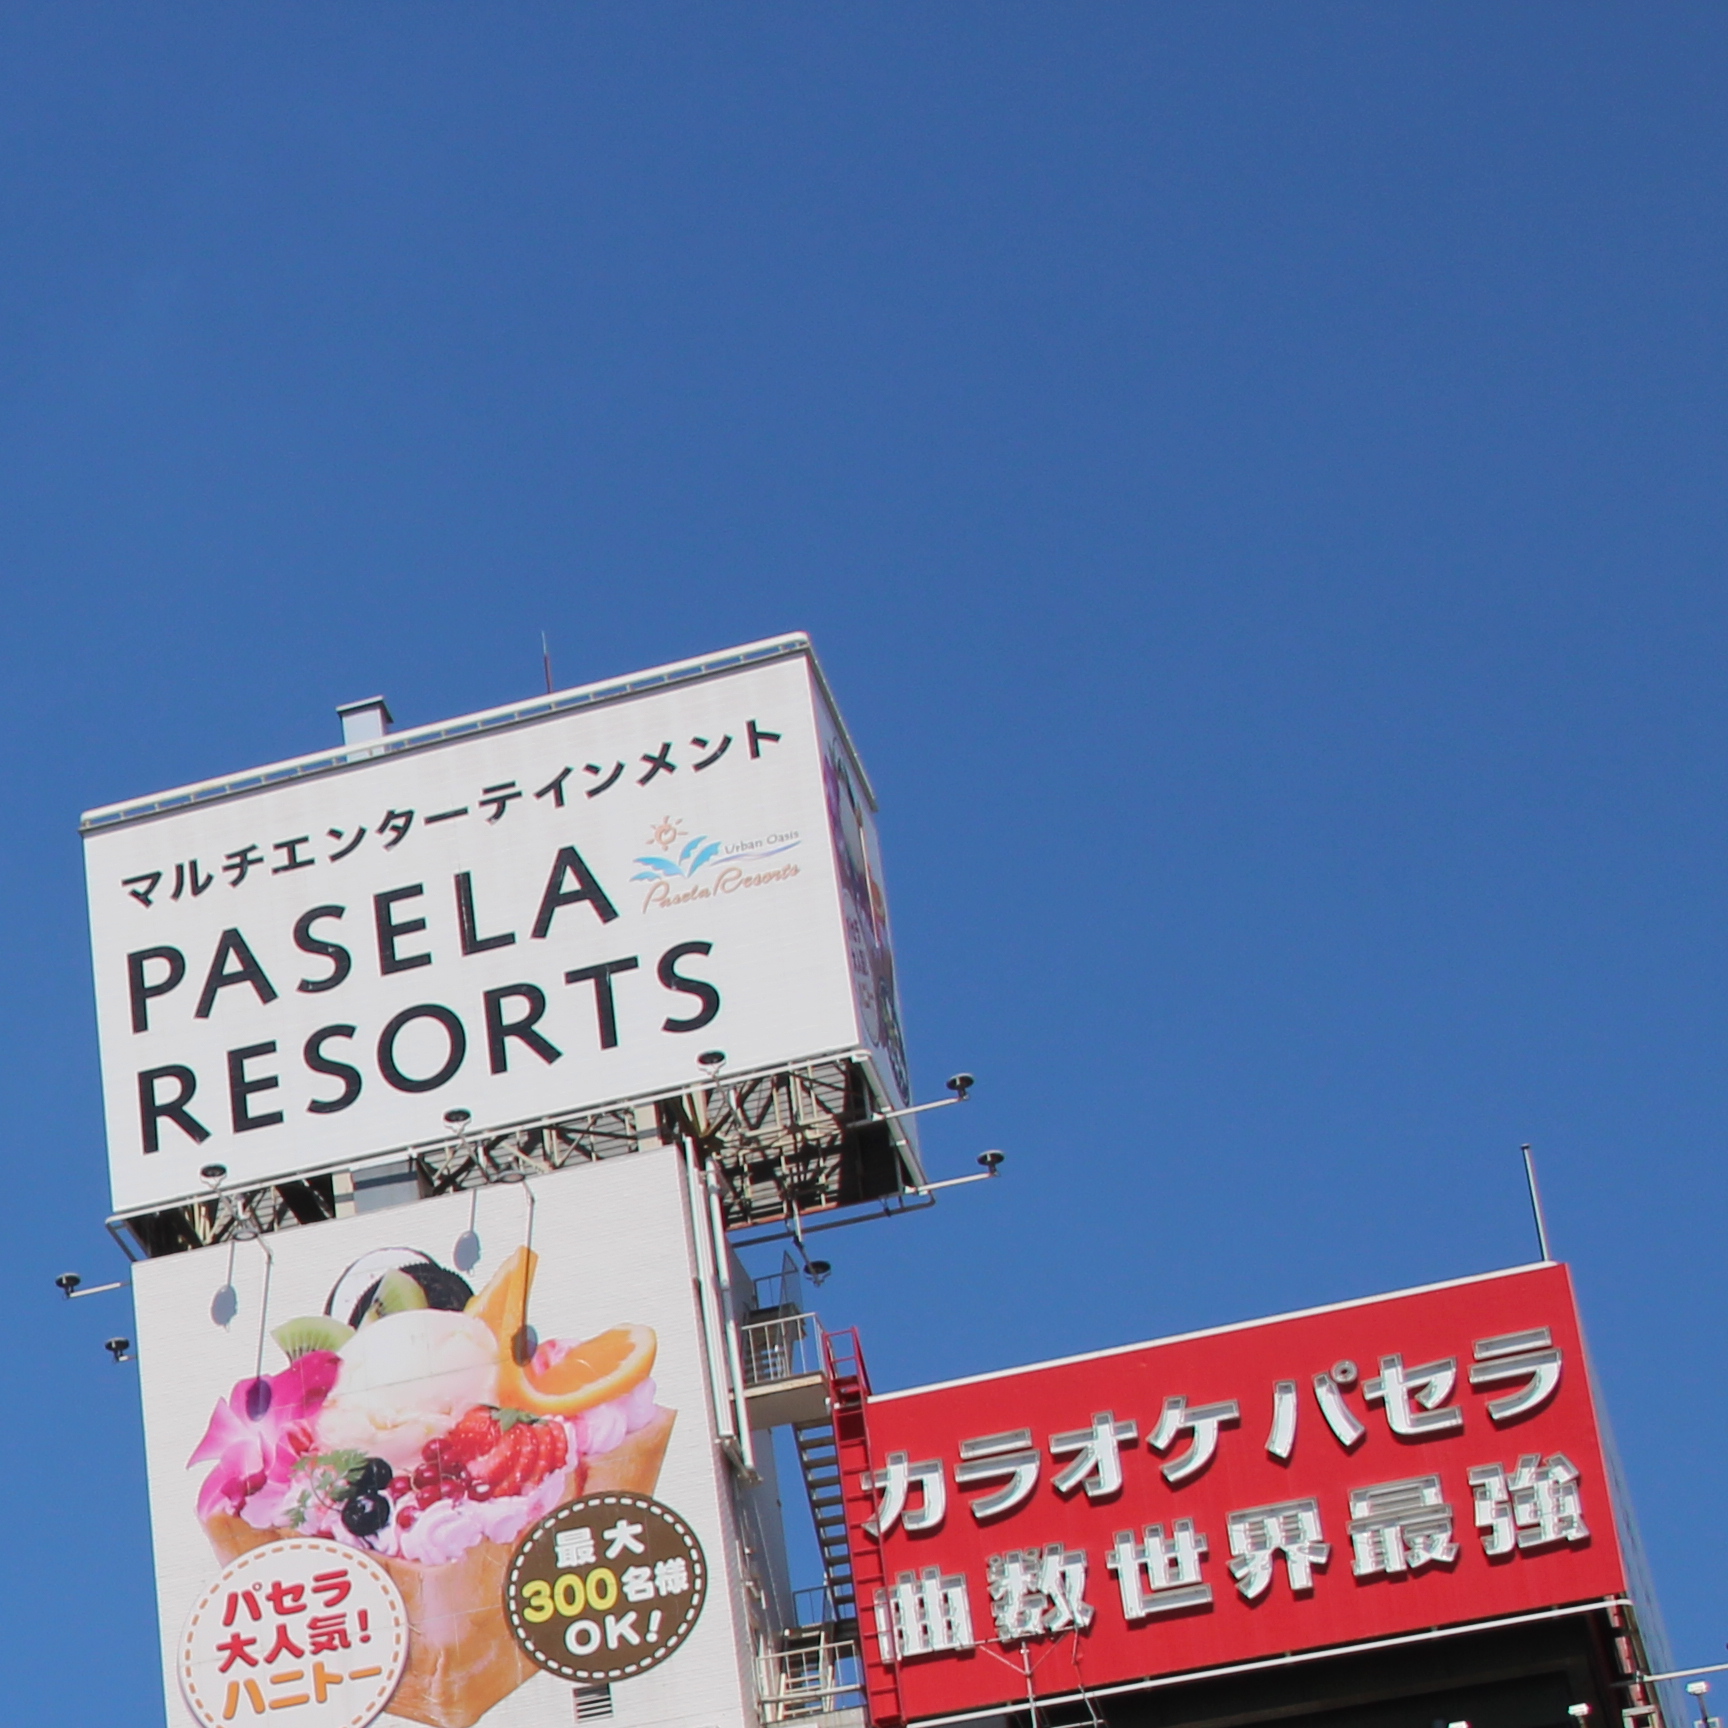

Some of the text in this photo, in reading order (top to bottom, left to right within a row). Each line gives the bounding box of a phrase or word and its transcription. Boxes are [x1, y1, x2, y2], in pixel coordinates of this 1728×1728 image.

[122, 719, 783, 908] マルチエンターテインメント
[725, 831, 799, 854] Urban Oasis
[643, 864, 800, 914] Pasela Resorts
[126, 845, 619, 1034] PASELA
[137, 941, 721, 1155] RESORTS
[553, 1519, 645, 1568] 最大
[875, 1452, 1590, 1663] 曲数世界最強
[222, 1569, 353, 1628] パセラ
[564, 1609, 663, 1657] OK!
[223, 1659, 383, 1721] ハニトー
